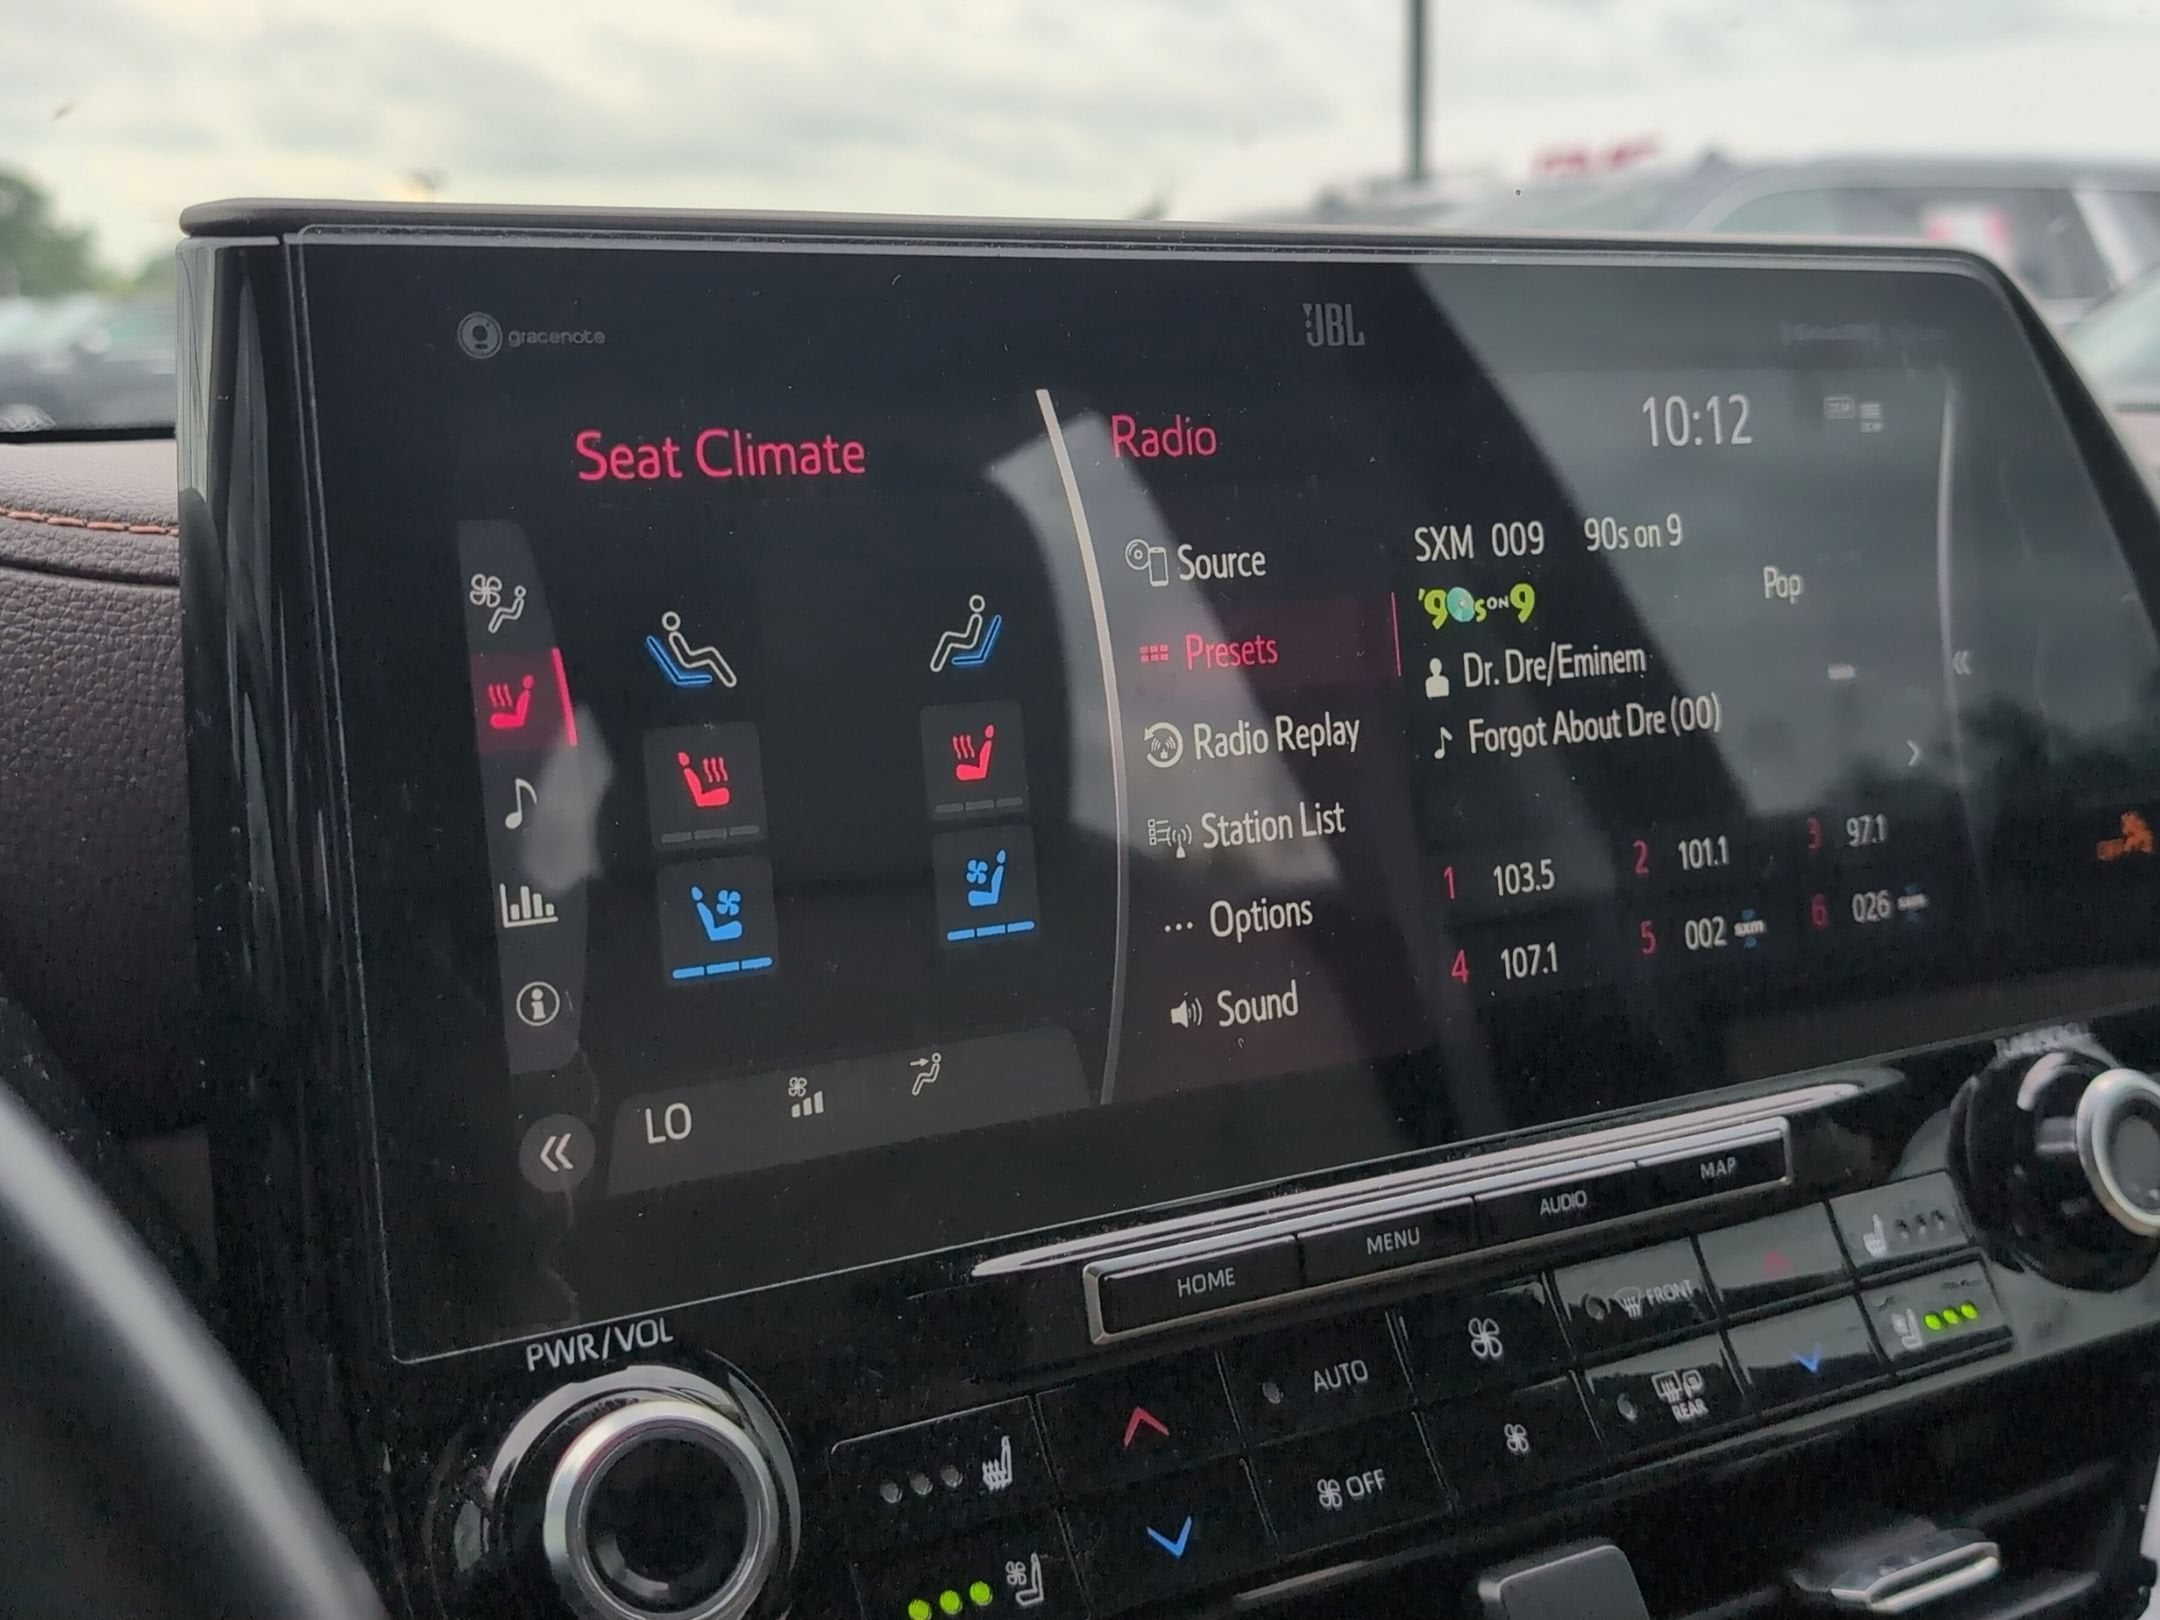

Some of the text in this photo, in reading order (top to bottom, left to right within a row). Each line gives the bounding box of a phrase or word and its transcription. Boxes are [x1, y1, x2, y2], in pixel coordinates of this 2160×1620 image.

[1303, 303, 1365, 346] JBL
[1110, 413, 1218, 458] Radio
[1642, 394, 1753, 447] 10:12
[575, 429, 866, 481] Seat Climate
[1414, 521, 1545, 562] SXM 009
[1584, 513, 1683, 551] 90s on 9
[1176, 544, 1267, 581] Source
[1763, 565, 1803, 603] Pop
[1185, 633, 1279, 671] Presets
[1463, 641, 1647, 688] Dr. Dre/Eminem
[1193, 711, 1361, 760] Radio Replay
[1468, 691, 1722, 758] Forgot About Dre (00)
[1201, 801, 1346, 849] Station List
[1807, 814, 1889, 851] 3 97.1
[1632, 835, 1730, 876] 2 101.1
[1443, 858, 1556, 900] 1 103.5
[1209, 897, 1314, 943] Options
[1811, 893, 1829, 930] 6
[1851, 889, 1891, 924] 026
[1640, 920, 1657, 955] 5
[1684, 915, 1727, 951] 002
[1451, 942, 1558, 984] 4 107.1
[1216, 979, 1300, 1027] Sound
[645, 1102, 693, 1145] LO
[1700, 1156, 1737, 1182] MAP
[1539, 1189, 1588, 1217] AUDIO
[1366, 1226, 1421, 1256] MENU
[1176, 1267, 1237, 1299] HOME
[1645, 1279, 1694, 1307] FRONT
[525, 1316, 674, 1373] PWR/VOL
[1314, 1359, 1370, 1394] AUTO
[1345, 1468, 1386, 1499] OFF
